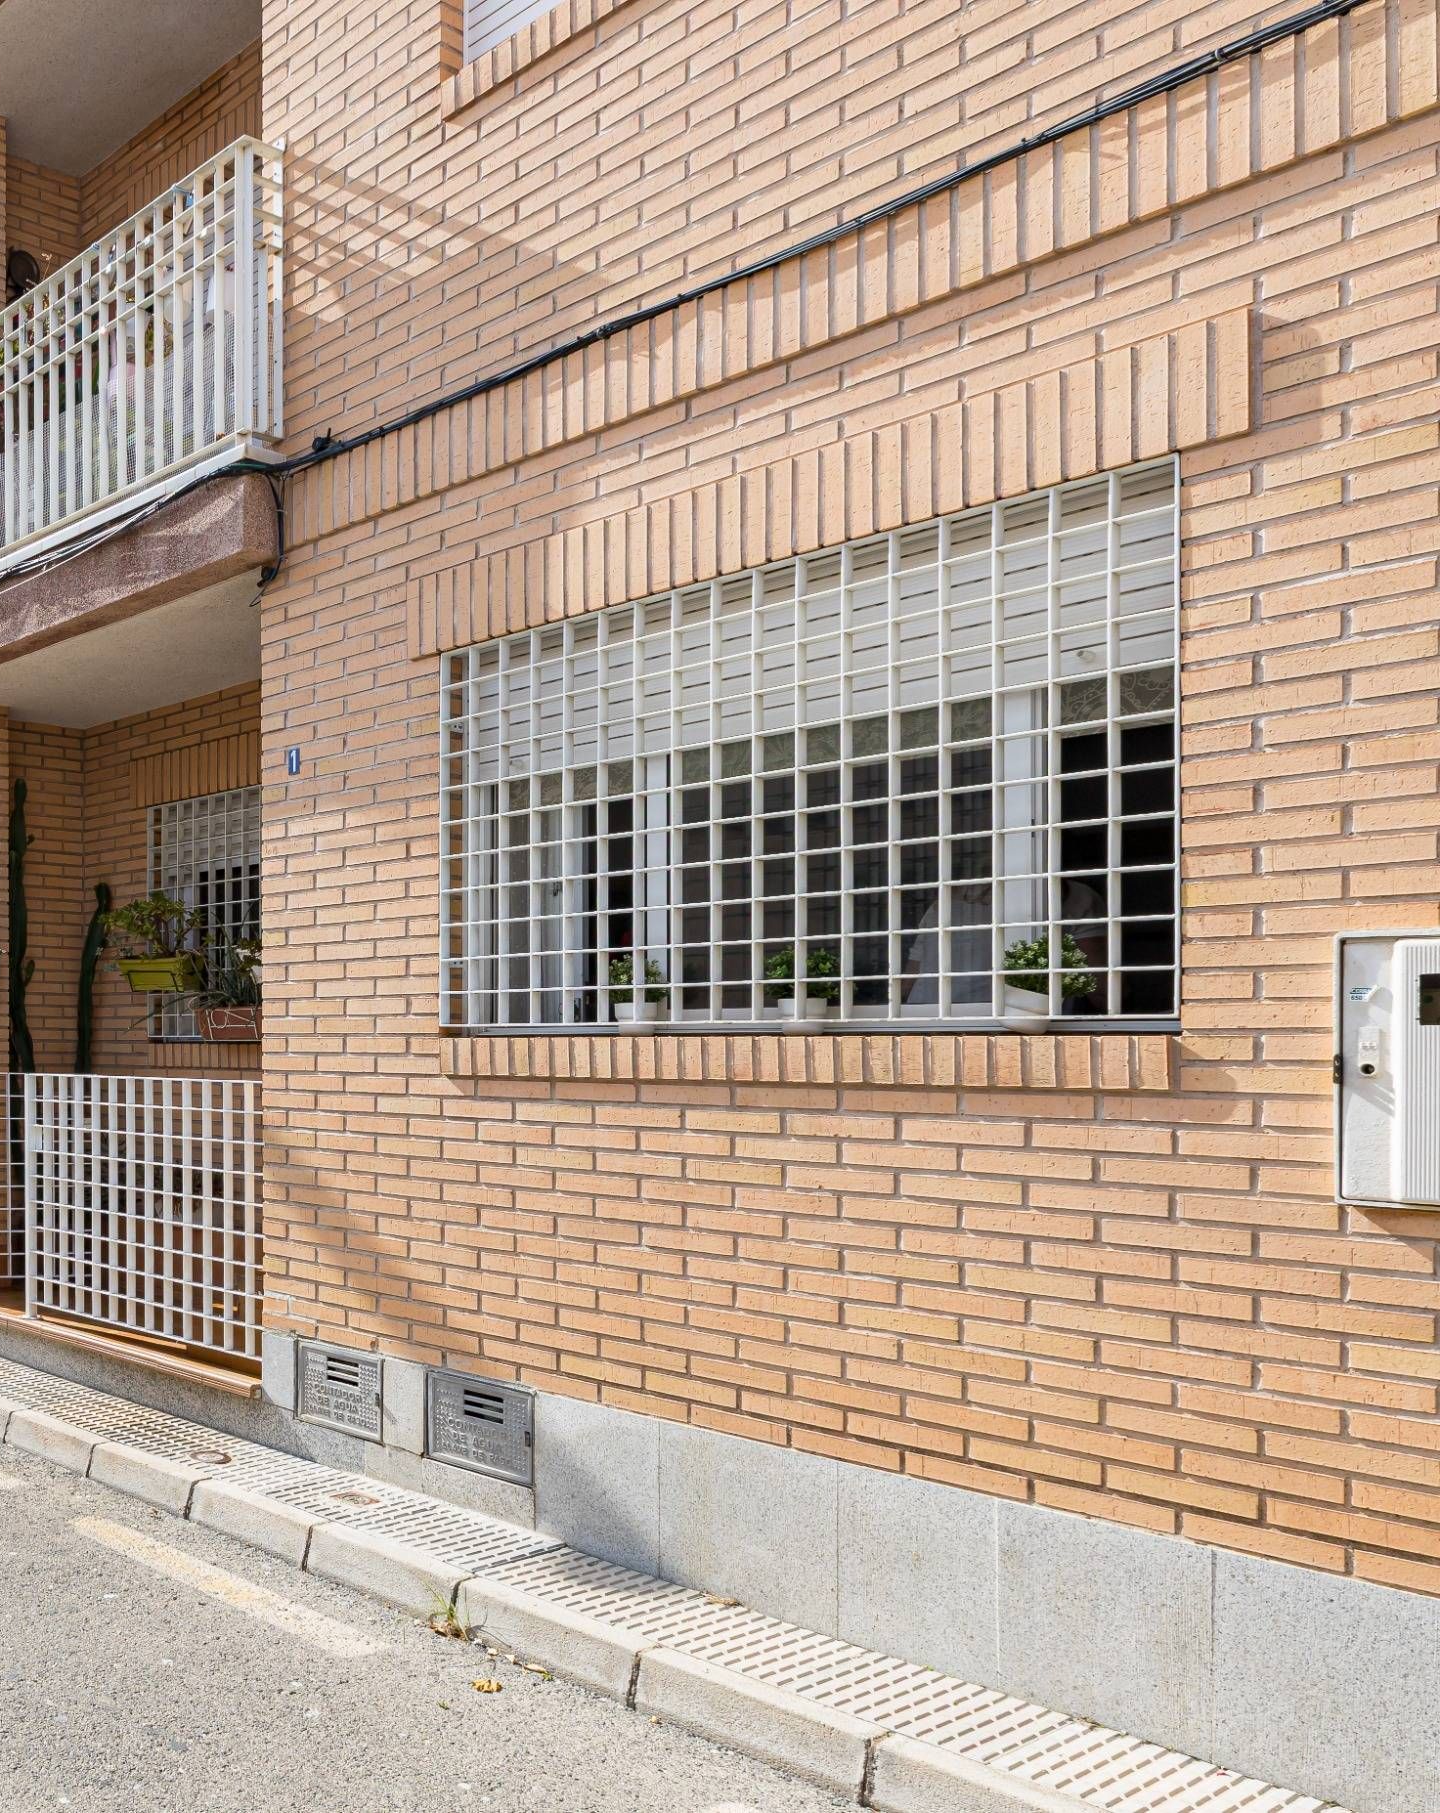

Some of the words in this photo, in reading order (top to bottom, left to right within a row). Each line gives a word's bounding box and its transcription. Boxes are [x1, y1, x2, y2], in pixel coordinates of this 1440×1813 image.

[290, 749, 297, 773] 1
[314, 1383, 363, 1404] CONTADOR
[317, 1394, 330, 1406] DE
[334, 1399, 358, 1414] AGUA
[452, 1429, 467, 1442] DE
